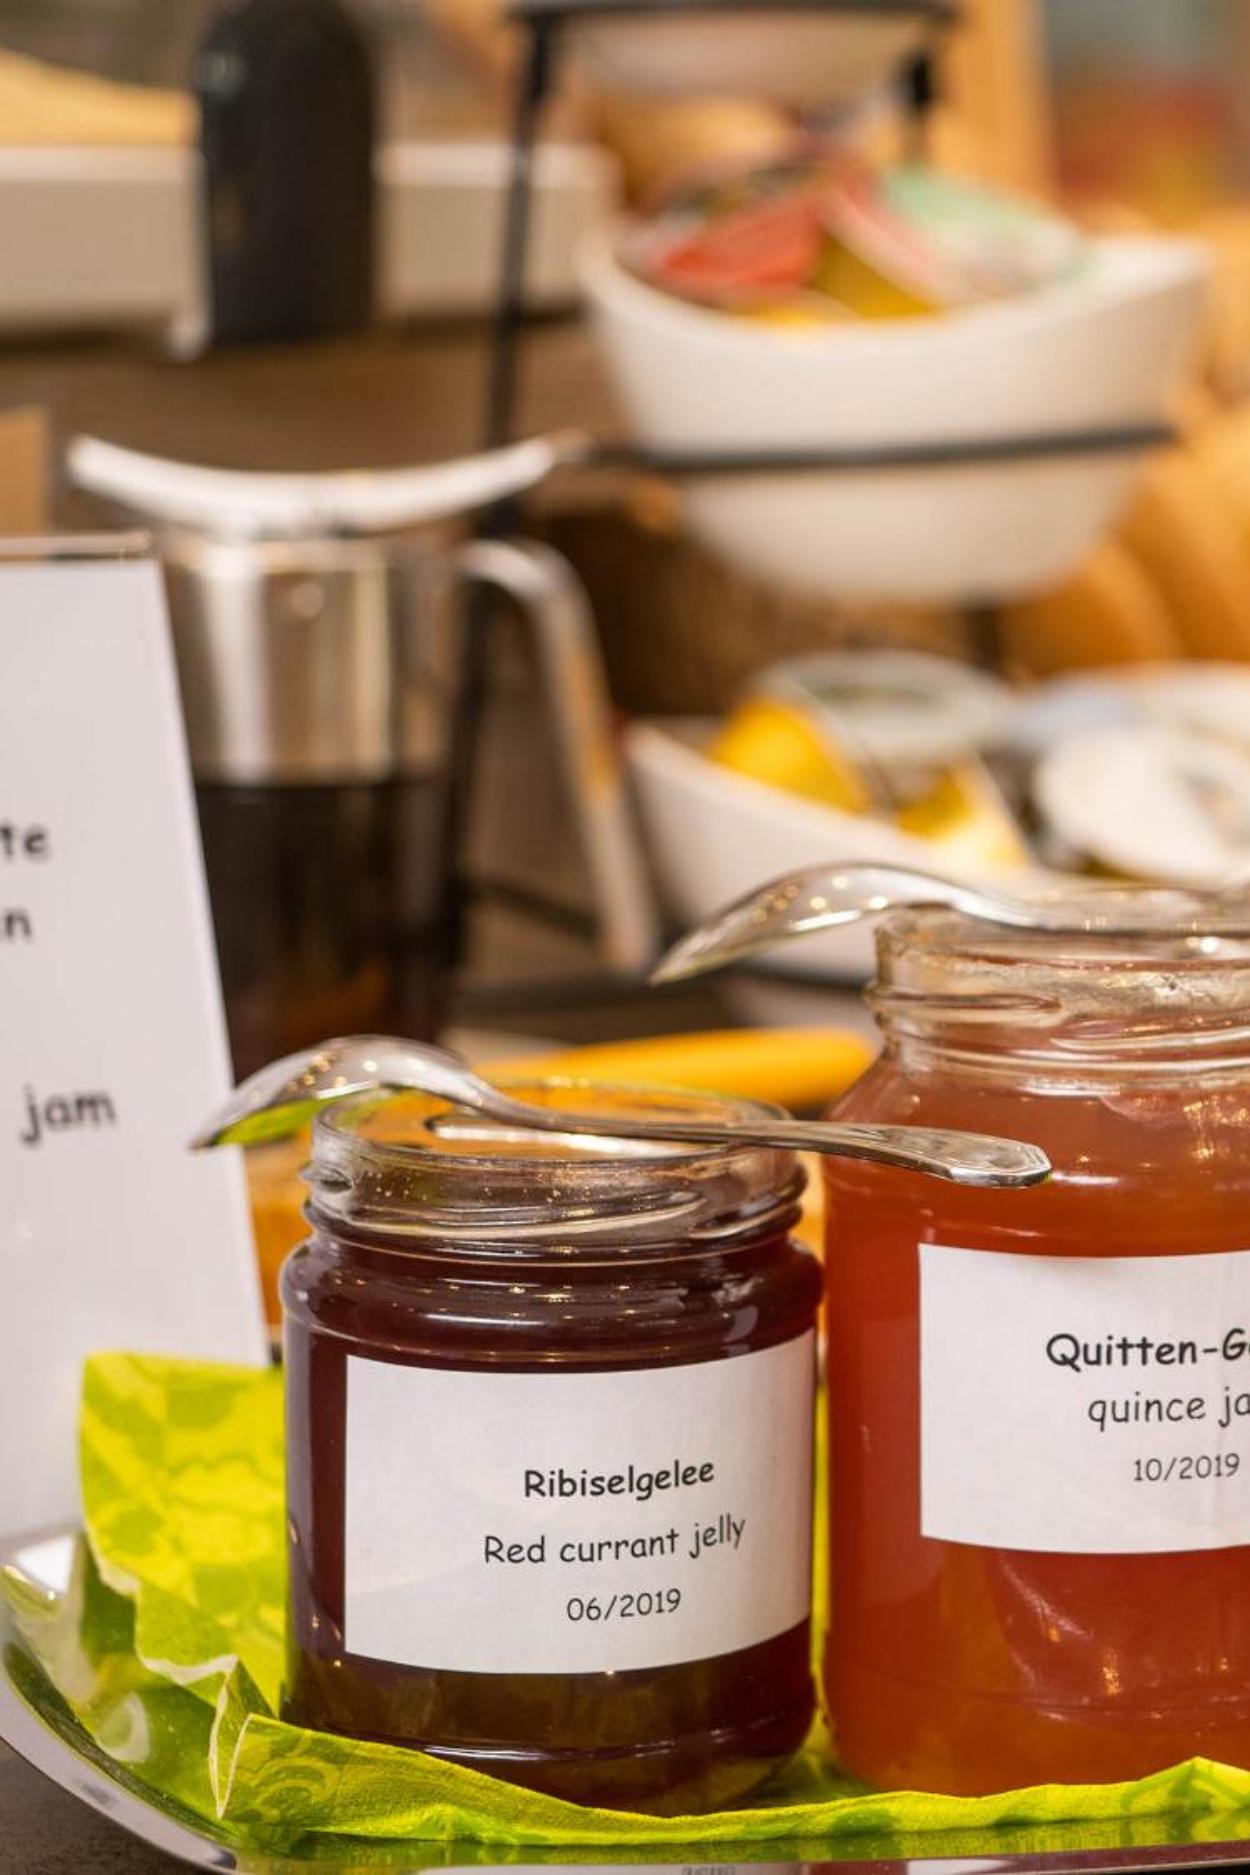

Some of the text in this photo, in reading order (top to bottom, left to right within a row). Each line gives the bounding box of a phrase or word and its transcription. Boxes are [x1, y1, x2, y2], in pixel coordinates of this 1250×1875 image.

[20, 1087, 117, 1147] jam
[1088, 1390, 1206, 1432] quince
[523, 1459, 716, 1500] Ribiselgelee
[1133, 1452, 1240, 1481] 10/2019
[484, 1512, 747, 1565] Red currant jelly
[566, 1588, 682, 1622] 06/2019
